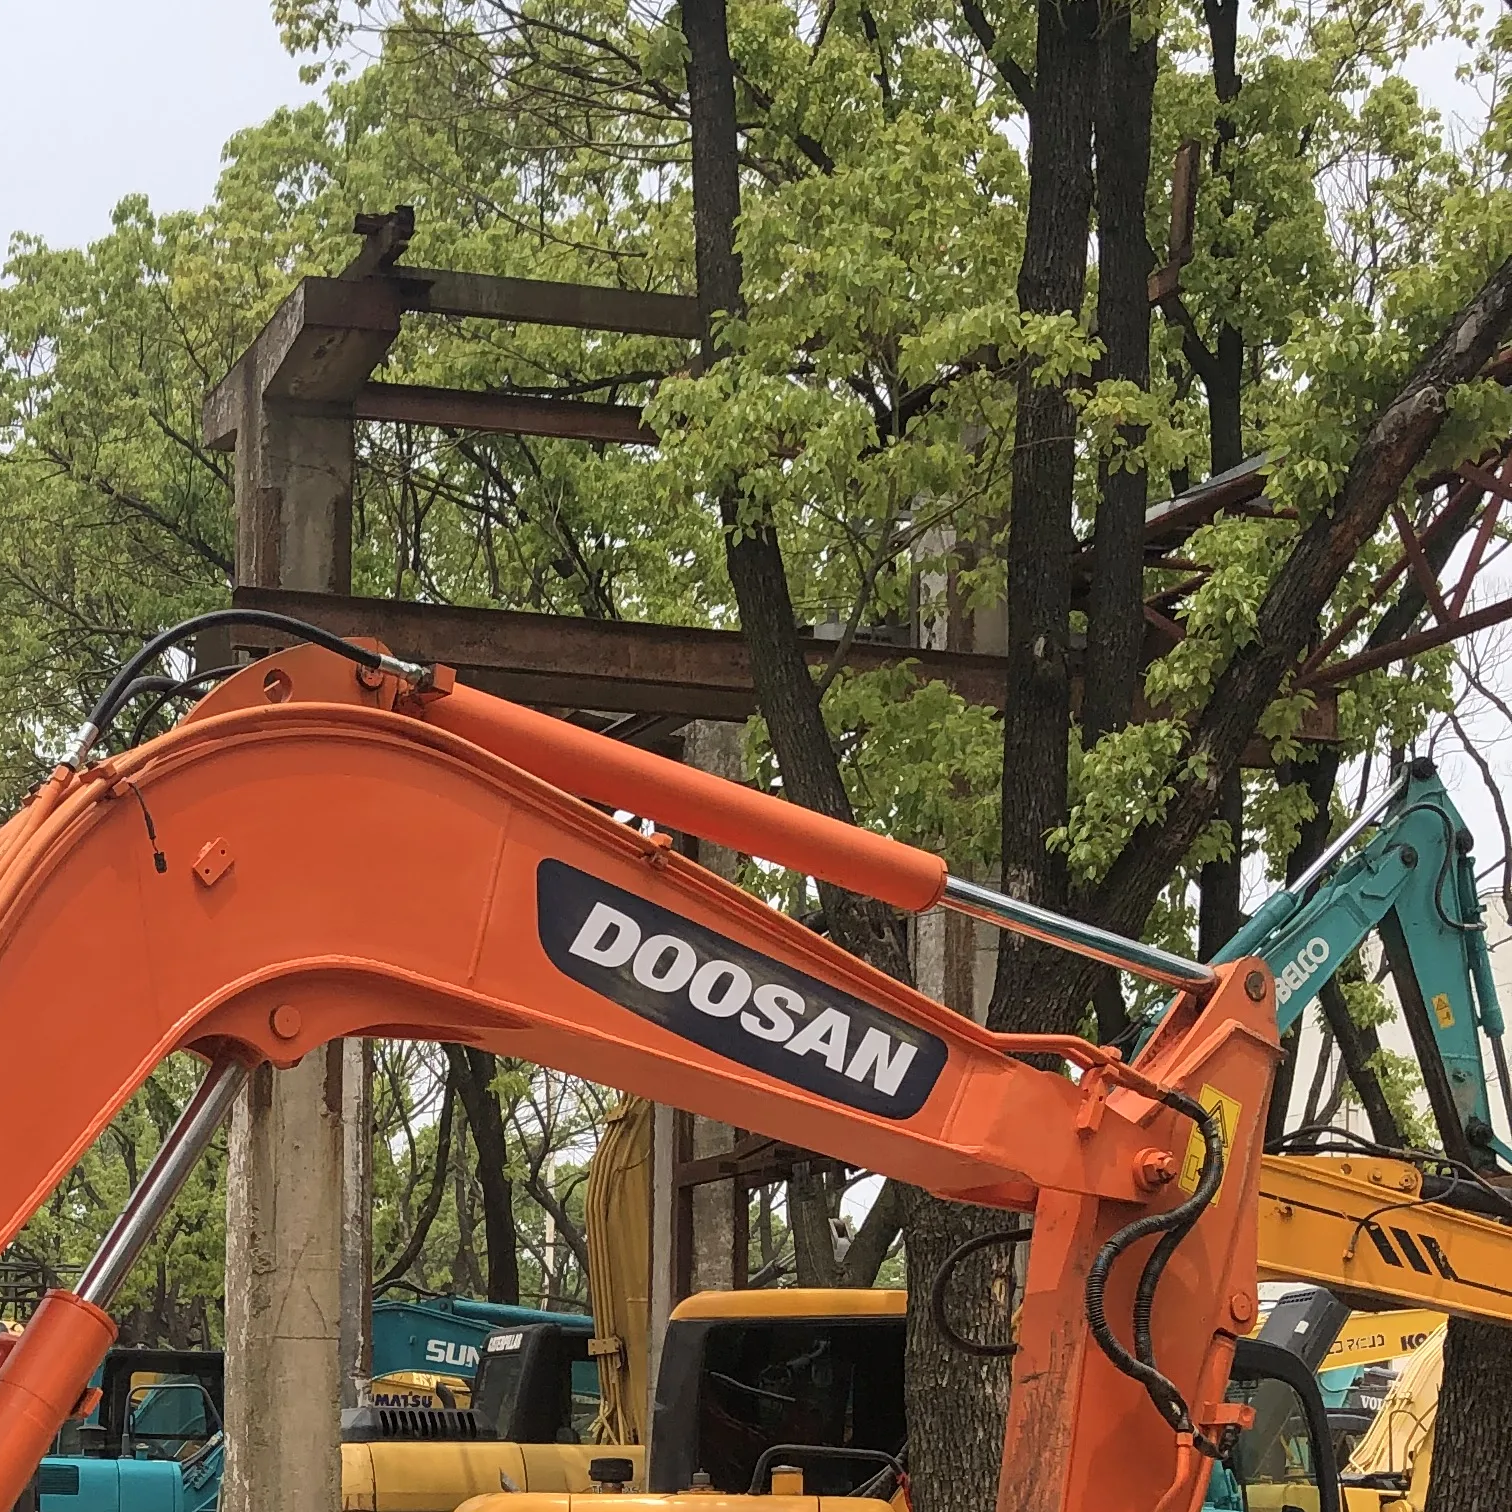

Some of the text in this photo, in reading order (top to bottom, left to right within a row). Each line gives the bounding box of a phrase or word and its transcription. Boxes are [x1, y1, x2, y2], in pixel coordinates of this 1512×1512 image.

[569, 902, 918, 1096] DOOSAN
[1274, 937, 1330, 1011] BELCO
[372, 1393, 433, 1408] MATSU
